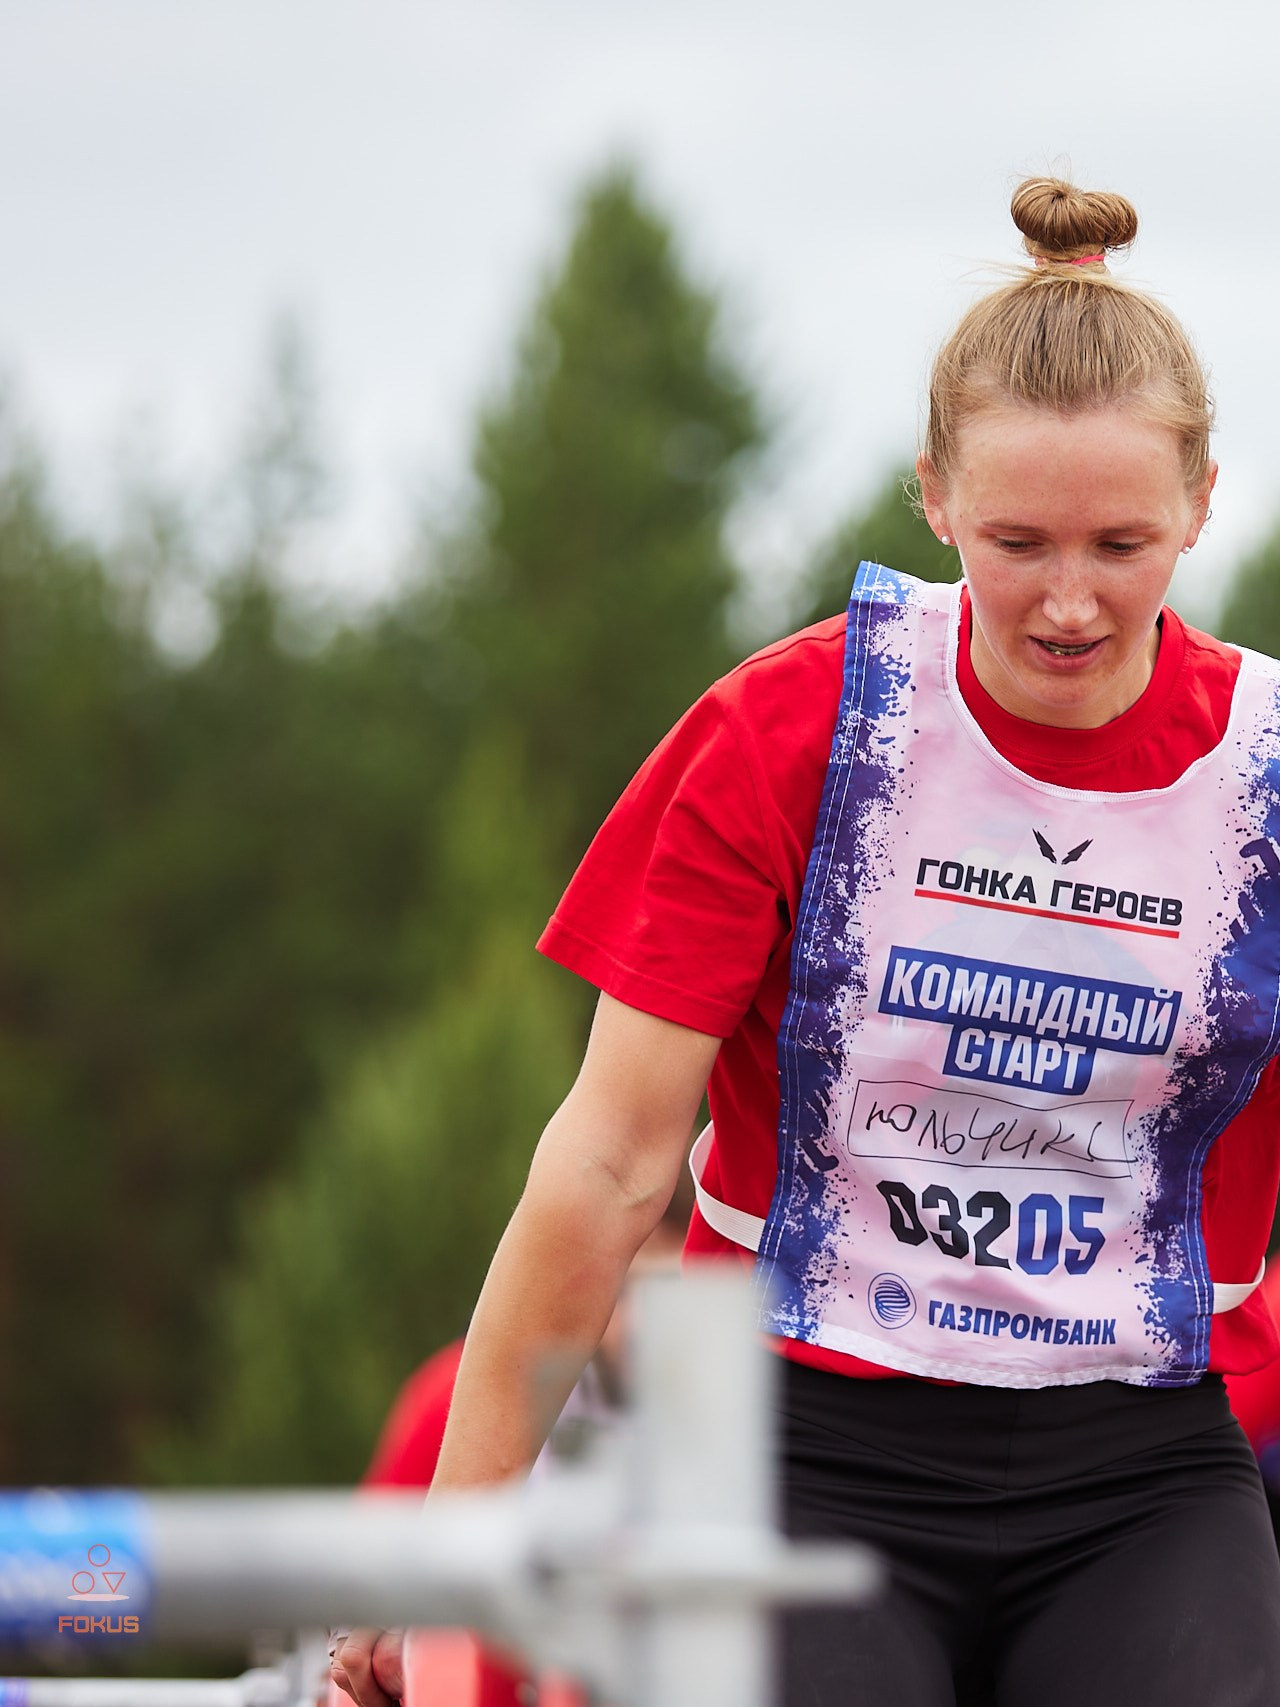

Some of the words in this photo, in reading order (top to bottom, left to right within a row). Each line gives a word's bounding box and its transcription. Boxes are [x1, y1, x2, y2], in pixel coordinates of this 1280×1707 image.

[916, 858, 1037, 904] ГОНКА
[1050, 880, 1183, 926] ГЕРОЕВ
[888, 958, 1175, 1047] КОМАНДНЫЙ
[953, 1027, 1088, 1089] СТАРТ
[876, 1180, 1105, 1275] 03205
[928, 1299, 1117, 1346] ГАЗПРОМБАНК
